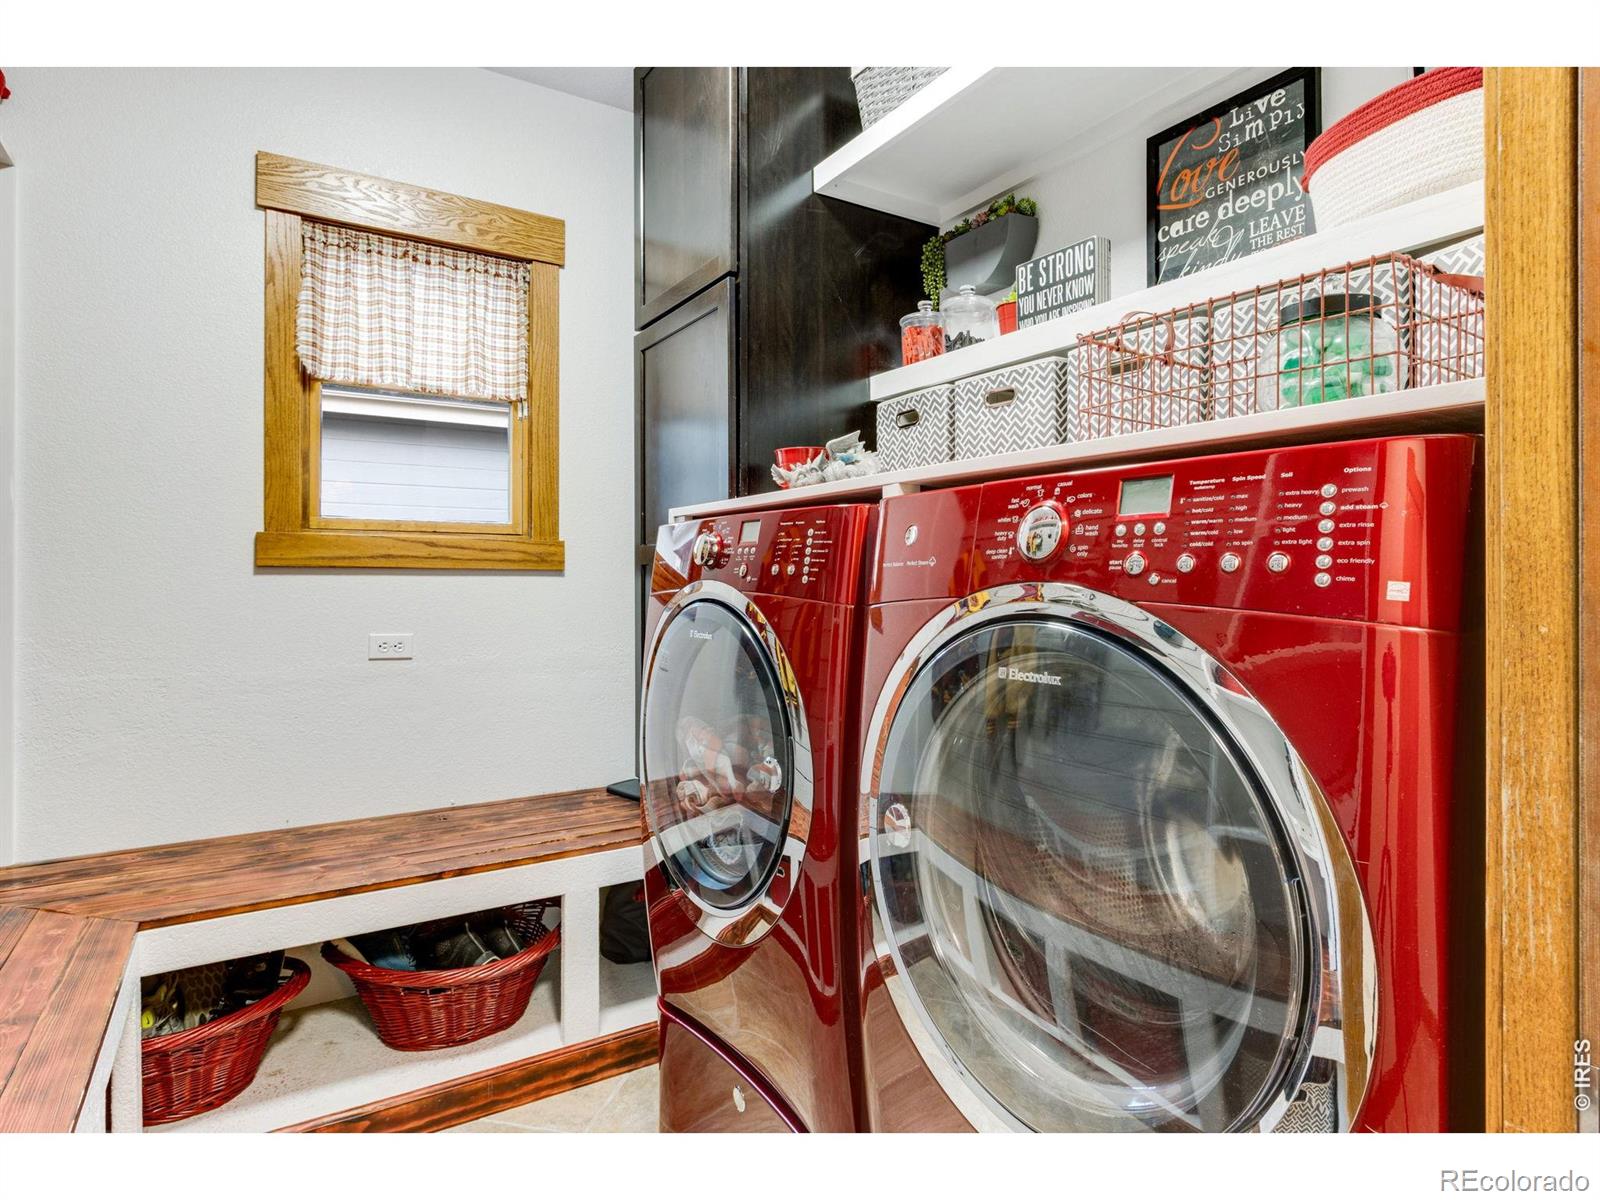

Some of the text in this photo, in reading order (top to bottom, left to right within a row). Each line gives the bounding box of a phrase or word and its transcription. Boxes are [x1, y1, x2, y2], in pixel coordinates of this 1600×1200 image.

[1229, 88, 1286, 128] Live
[1156, 117, 1241, 210] Love
[1157, 210, 1210, 242] care
[1249, 203, 1306, 238] LEAVE
[1249, 222, 1305, 250] THE REST
[1018, 240, 1094, 295] BE STRONG
[1018, 273, 1095, 317] YOU NEVER KNOW
[1300, 488, 1319, 496] heavy
[1349, 557, 1375, 565] friendly
[1009, 668, 1062, 686] Electrolux
